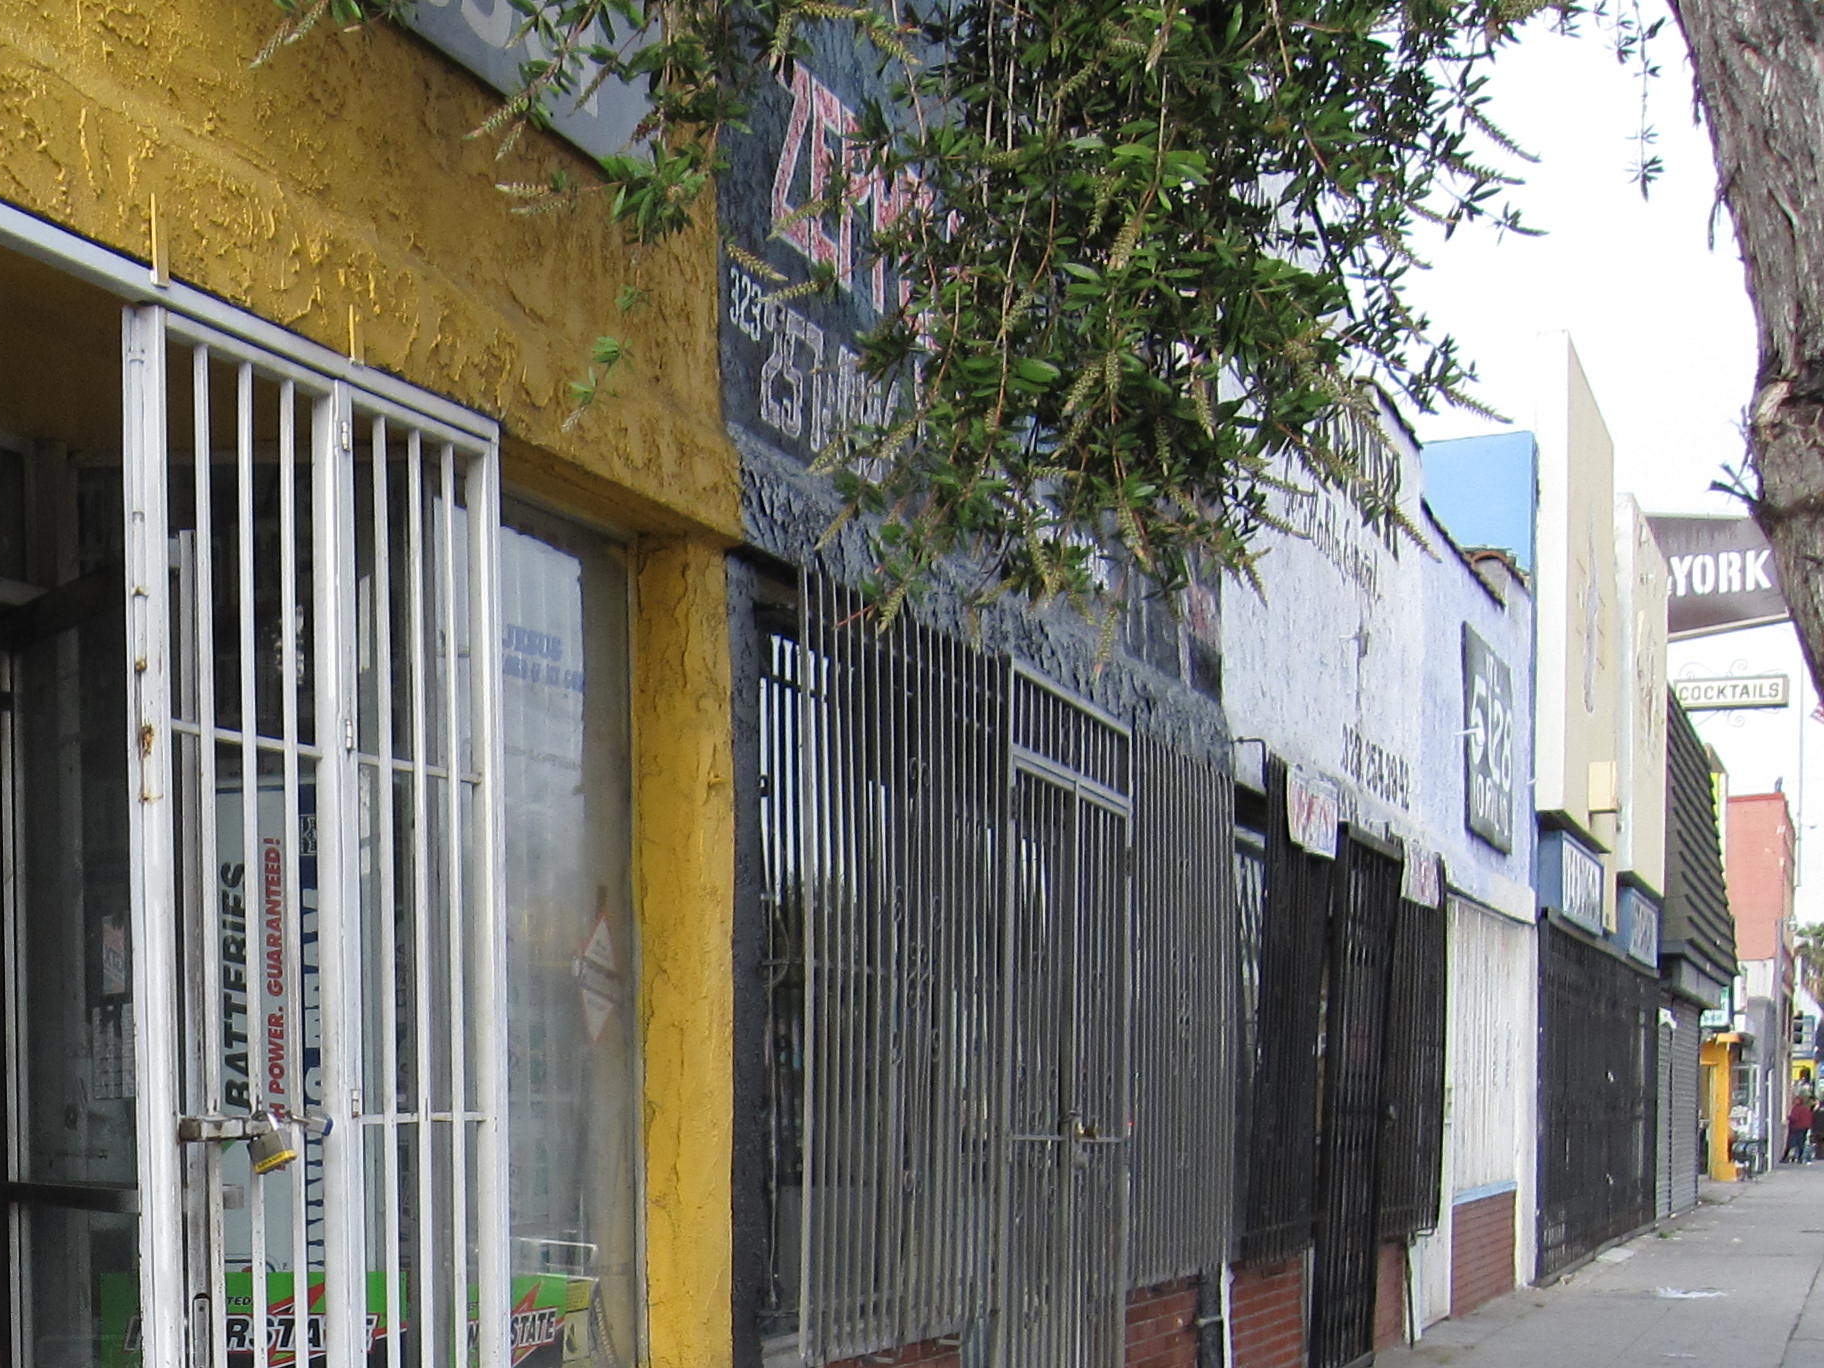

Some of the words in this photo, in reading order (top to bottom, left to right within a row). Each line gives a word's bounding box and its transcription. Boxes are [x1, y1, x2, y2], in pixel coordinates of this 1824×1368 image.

[1669, 549, 1773, 598] YORK
[1678, 682, 1780, 702] COCKTAILS
[262, 837, 285, 998] GUARANTEED!
[267, 1005, 286, 1095] POWER.
